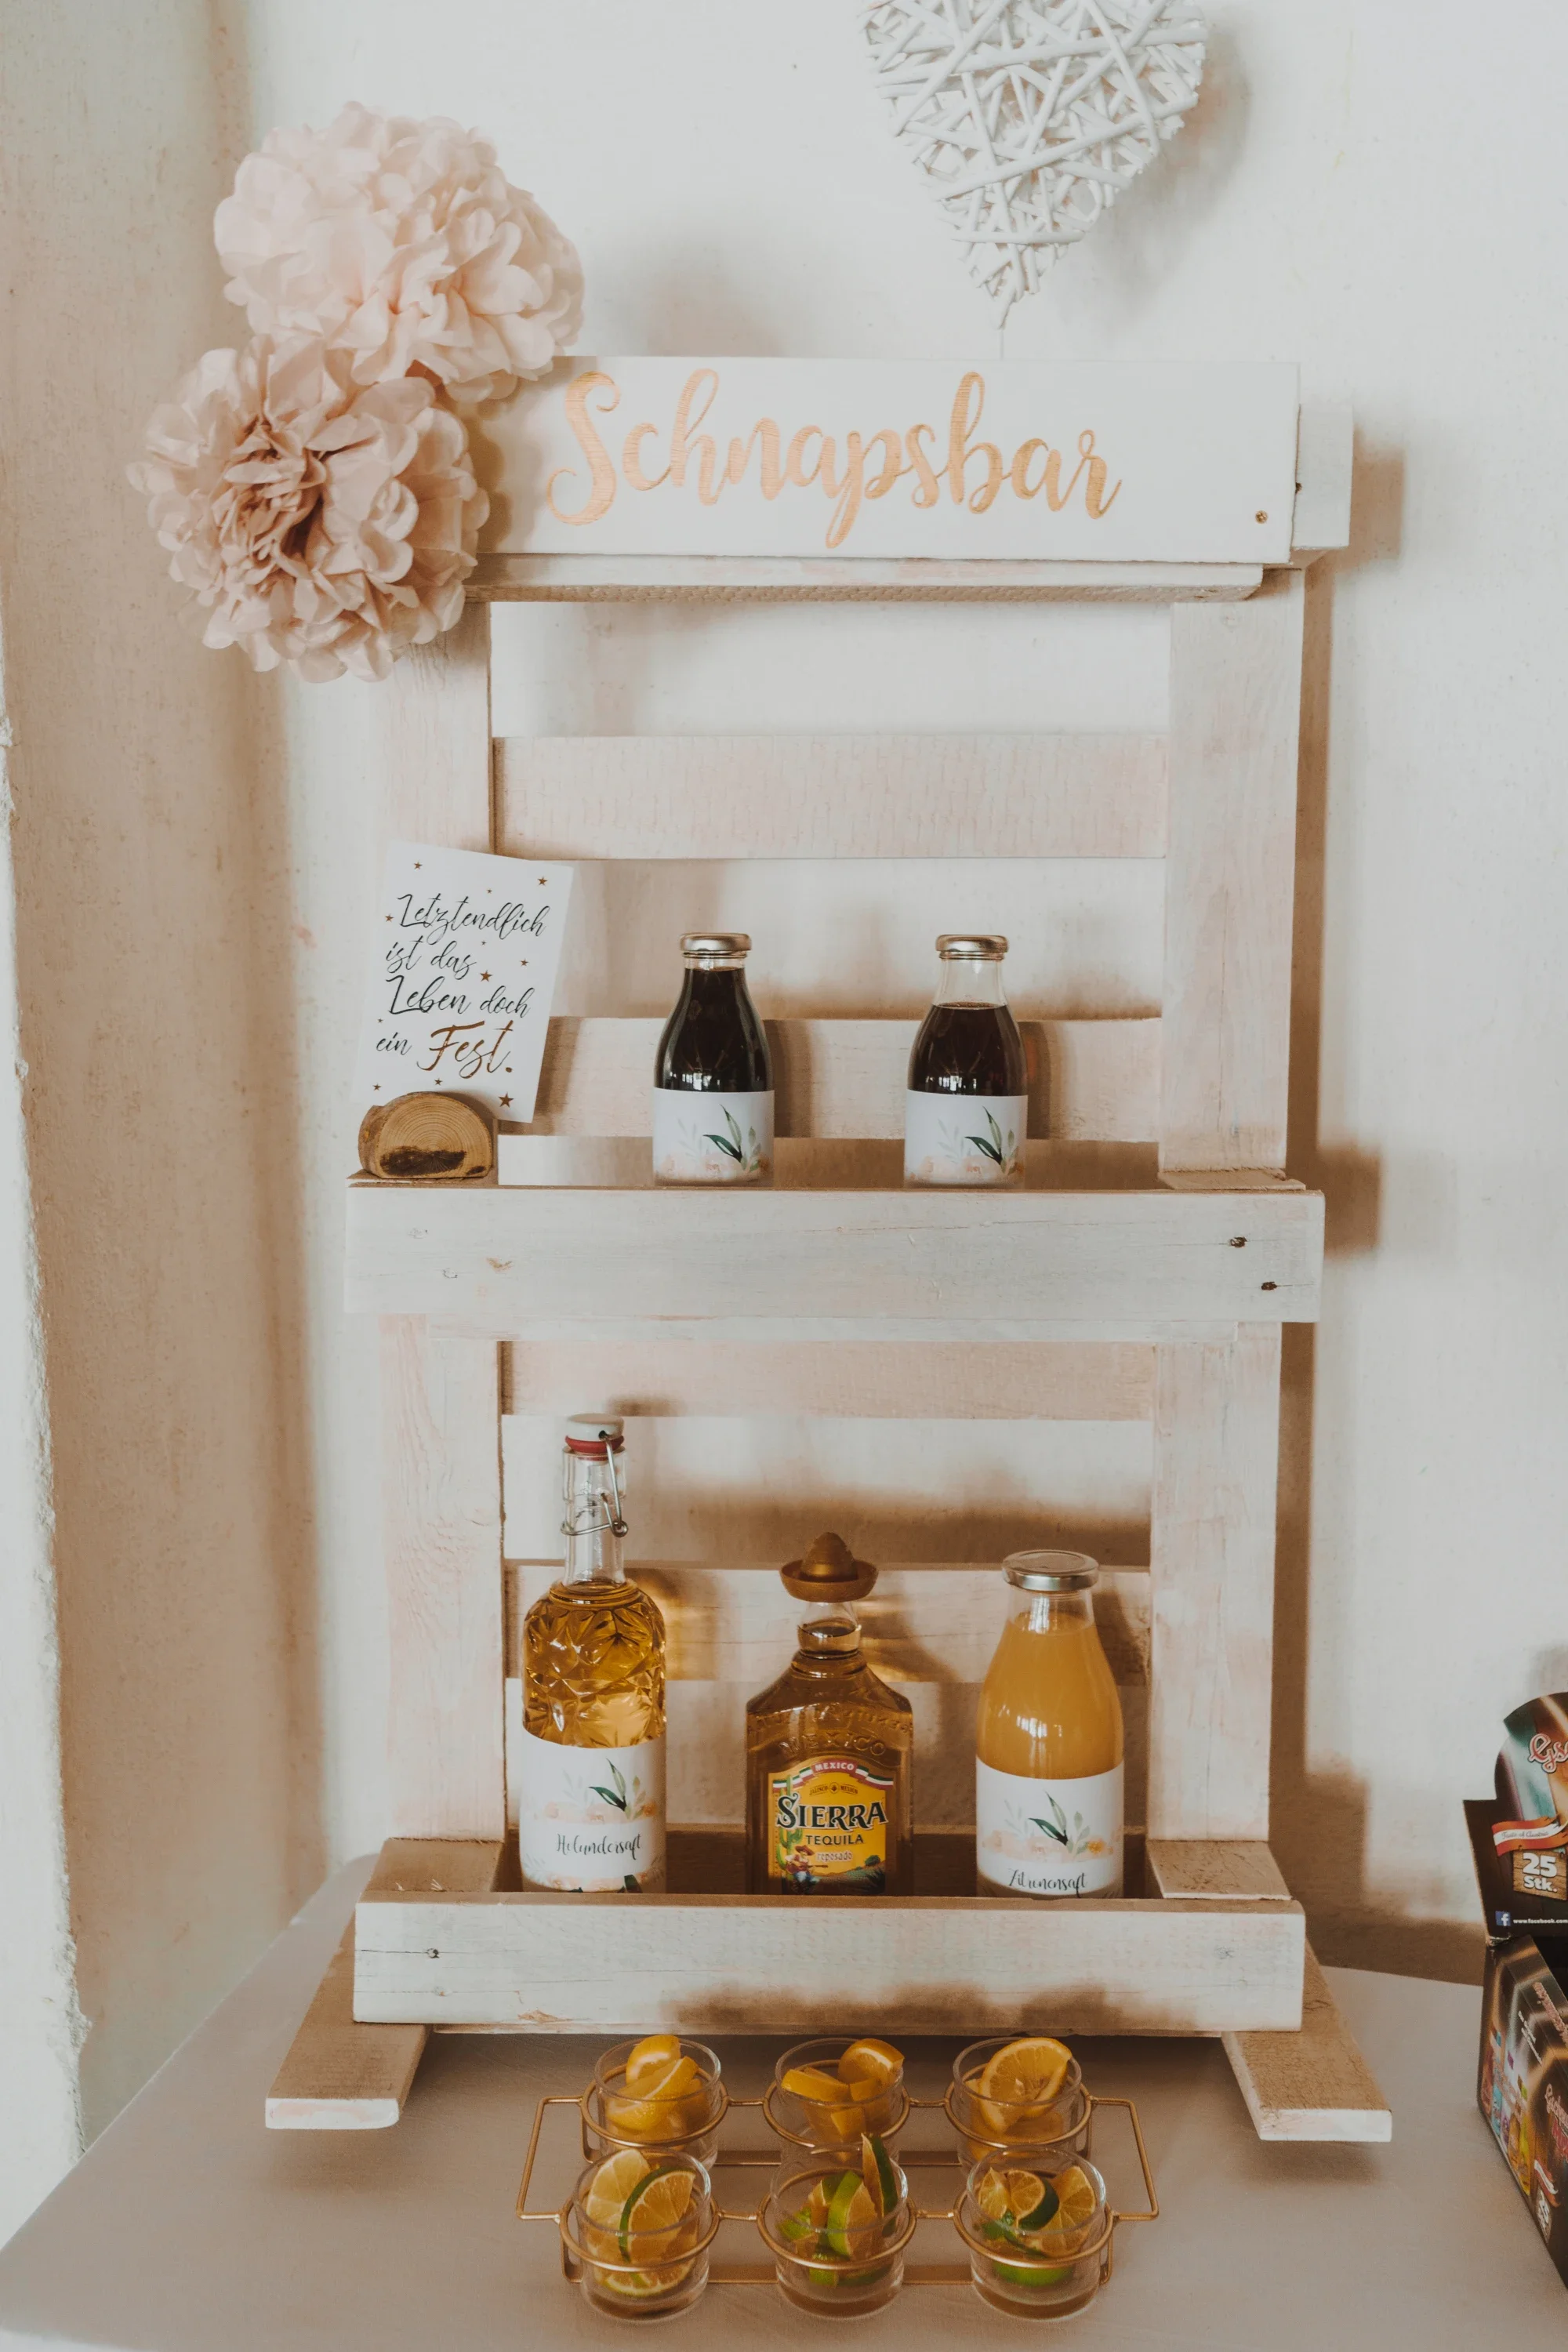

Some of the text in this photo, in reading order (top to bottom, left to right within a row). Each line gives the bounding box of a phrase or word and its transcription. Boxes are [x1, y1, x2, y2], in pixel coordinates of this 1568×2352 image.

[545, 368, 1122, 549] Schnapsbar
[397, 892, 550, 946] Letztendlich
[385, 935, 477, 980] ist das
[385, 975, 535, 1018] Leben doch
[376, 1019, 514, 1080] ein Fest.
[815, 1761, 855, 1772] MEXICO
[775, 1792, 888, 1831] SIERRA
[805, 1834, 864, 1846] TEQUILA
[816, 1849, 853, 1862] reposado
[1523, 1852, 1558, 1878] 25
[1523, 1875, 1558, 1893] Stk.
